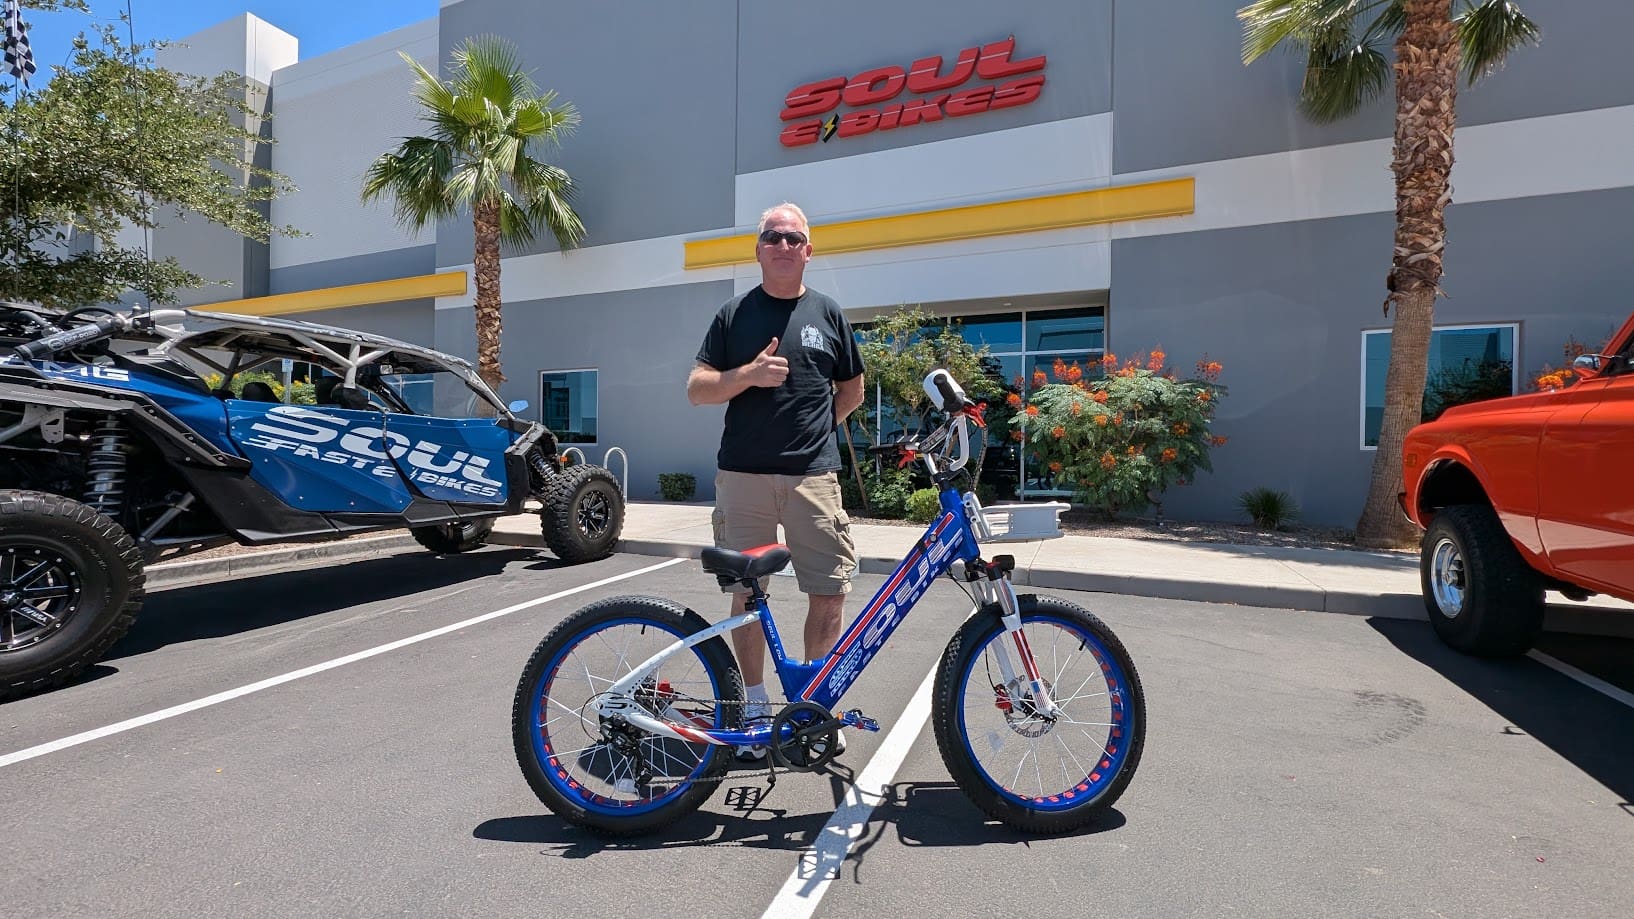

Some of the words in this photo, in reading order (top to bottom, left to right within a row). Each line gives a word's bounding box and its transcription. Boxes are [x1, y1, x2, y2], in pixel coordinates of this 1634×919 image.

[779, 36, 1046, 121] SOUL
[779, 119, 823, 147] E
[836, 75, 1046, 138] BIKES
[250, 406, 503, 487] SOUL
[416, 471, 500, 497] BIKES
[828, 528, 963, 698] SOUL
